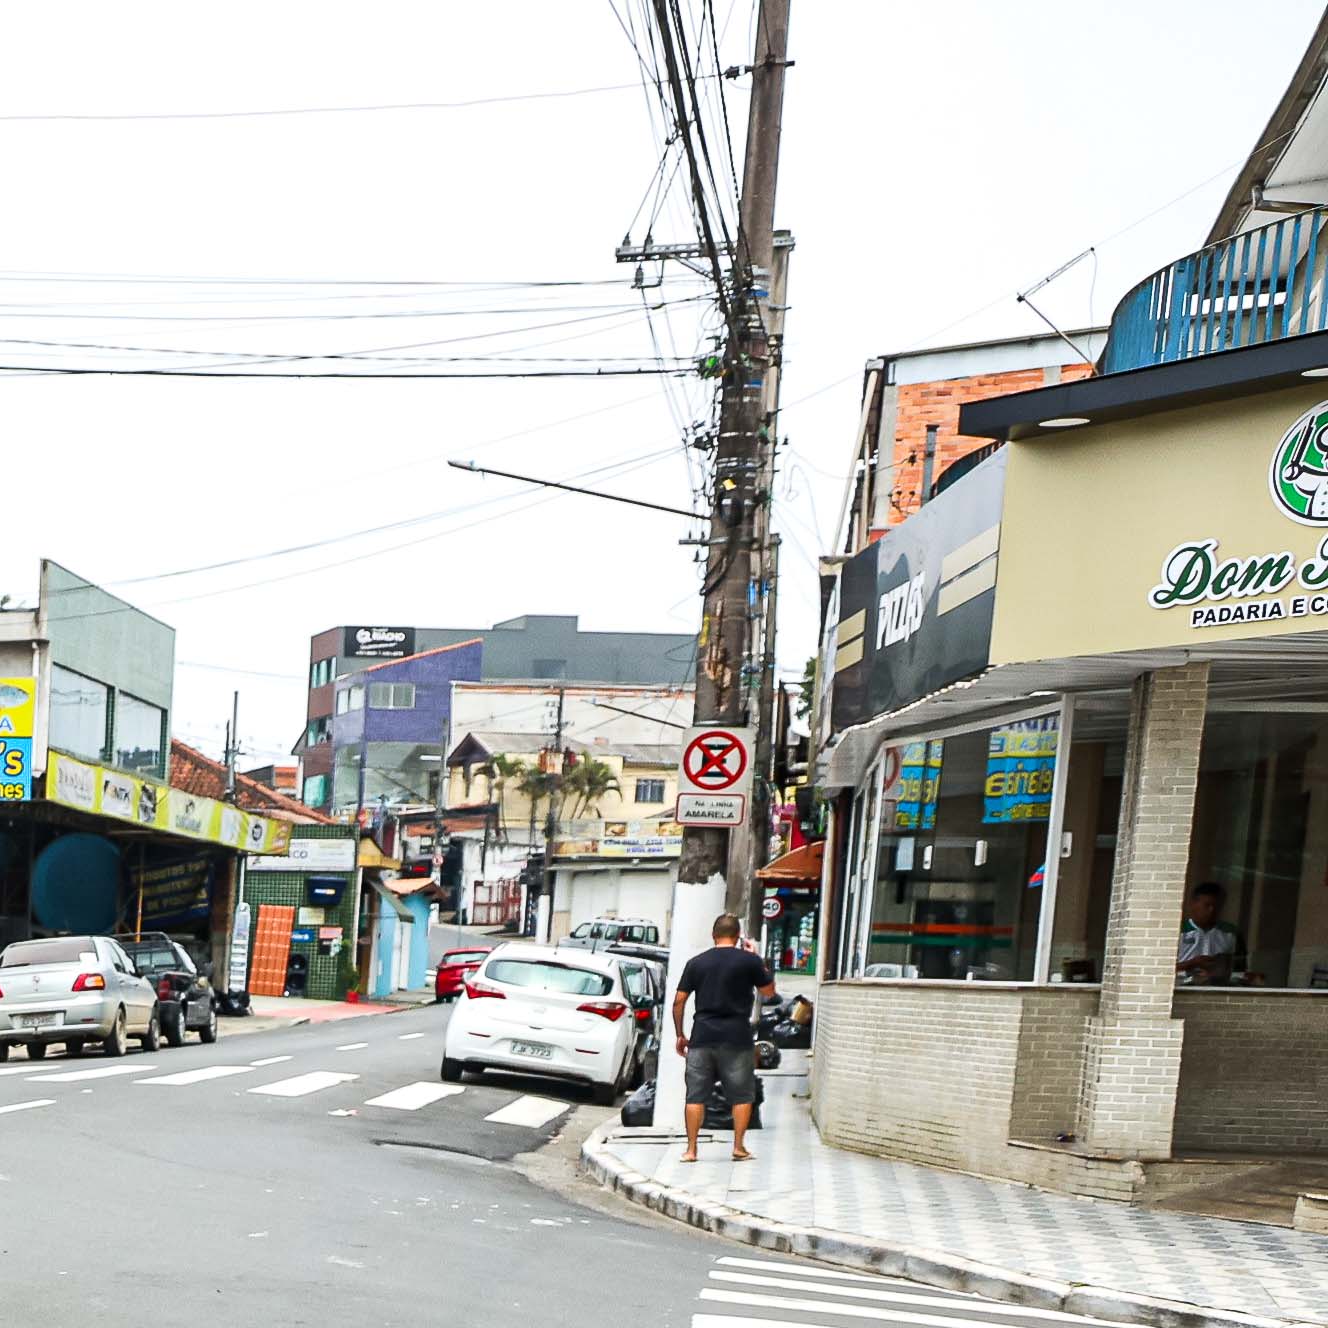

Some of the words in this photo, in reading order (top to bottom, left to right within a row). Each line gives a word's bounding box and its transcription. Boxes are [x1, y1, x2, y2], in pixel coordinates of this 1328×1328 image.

[1153, 542, 1292, 605] Dom
[875, 571, 927, 651] PIZZAS
[1192, 602, 1283, 625] PADARIA
[1293, 599, 1305, 614] E
[685, 811, 735, 819] AMARELA
